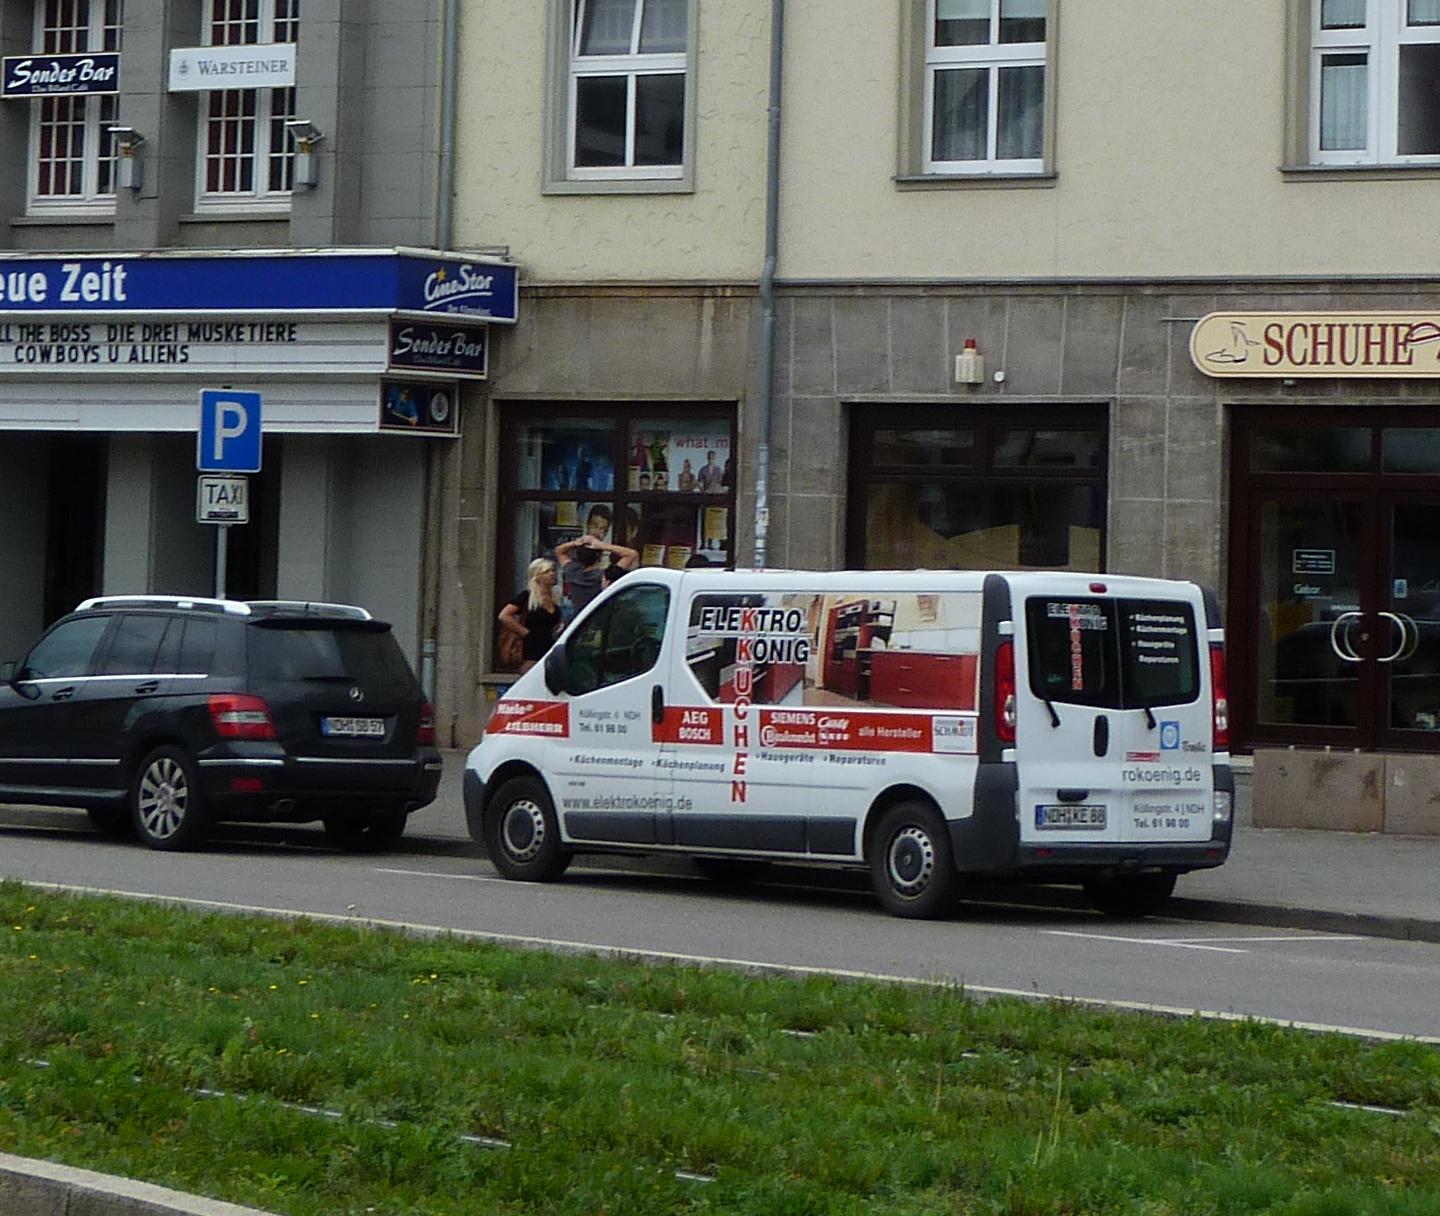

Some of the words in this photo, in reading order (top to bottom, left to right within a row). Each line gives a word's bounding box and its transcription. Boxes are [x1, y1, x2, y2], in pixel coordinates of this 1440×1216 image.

[7, 61, 77, 89] Sonder
[75, 58, 115, 82] Bar
[197, 59, 289, 76] WARSTEINER
[60, 262, 128, 302] Zeit
[424, 264, 494, 302] CineStar
[17, 324, 45, 342] THE
[49, 324, 91, 342] BOSS
[107, 323, 135, 342] DIE
[142, 323, 178, 342] DREI
[187, 323, 298, 342] MUSKETIERE
[393, 327, 451, 356] Sonder
[449, 332, 483, 357] Bar
[14, 344, 101, 363] COWBOYS
[108, 345, 119, 363] U
[128, 344, 190, 364] ALIENS
[1263, 322, 1413, 367] SCHUHE
[214, 401, 248, 460] P
[205, 484, 243, 505] TAXI
[701, 607, 802, 633] ELEKTRO
[505, 721, 564, 734] LIEBHERR
[579, 722, 592, 733] Tel.
[682, 711, 709, 725] AEG
[771, 712, 816, 725] SIEMENS
[679, 727, 711, 740] BOSCH
[877, 727, 922, 738] Hersteller
[574, 755, 644, 768] Küchenmontage
[656, 757, 726, 772] Küchenplanung
[761, 752, 815, 763] Hausgeräte
[828, 754, 887, 766] Reparaturen
[1122, 767, 1201, 785] rokoenig.de
[562, 794, 693, 813] www.elektrokoenig.de
[1186, 804, 1205, 814] NDH
[1134, 818, 1148, 828] Tel.
